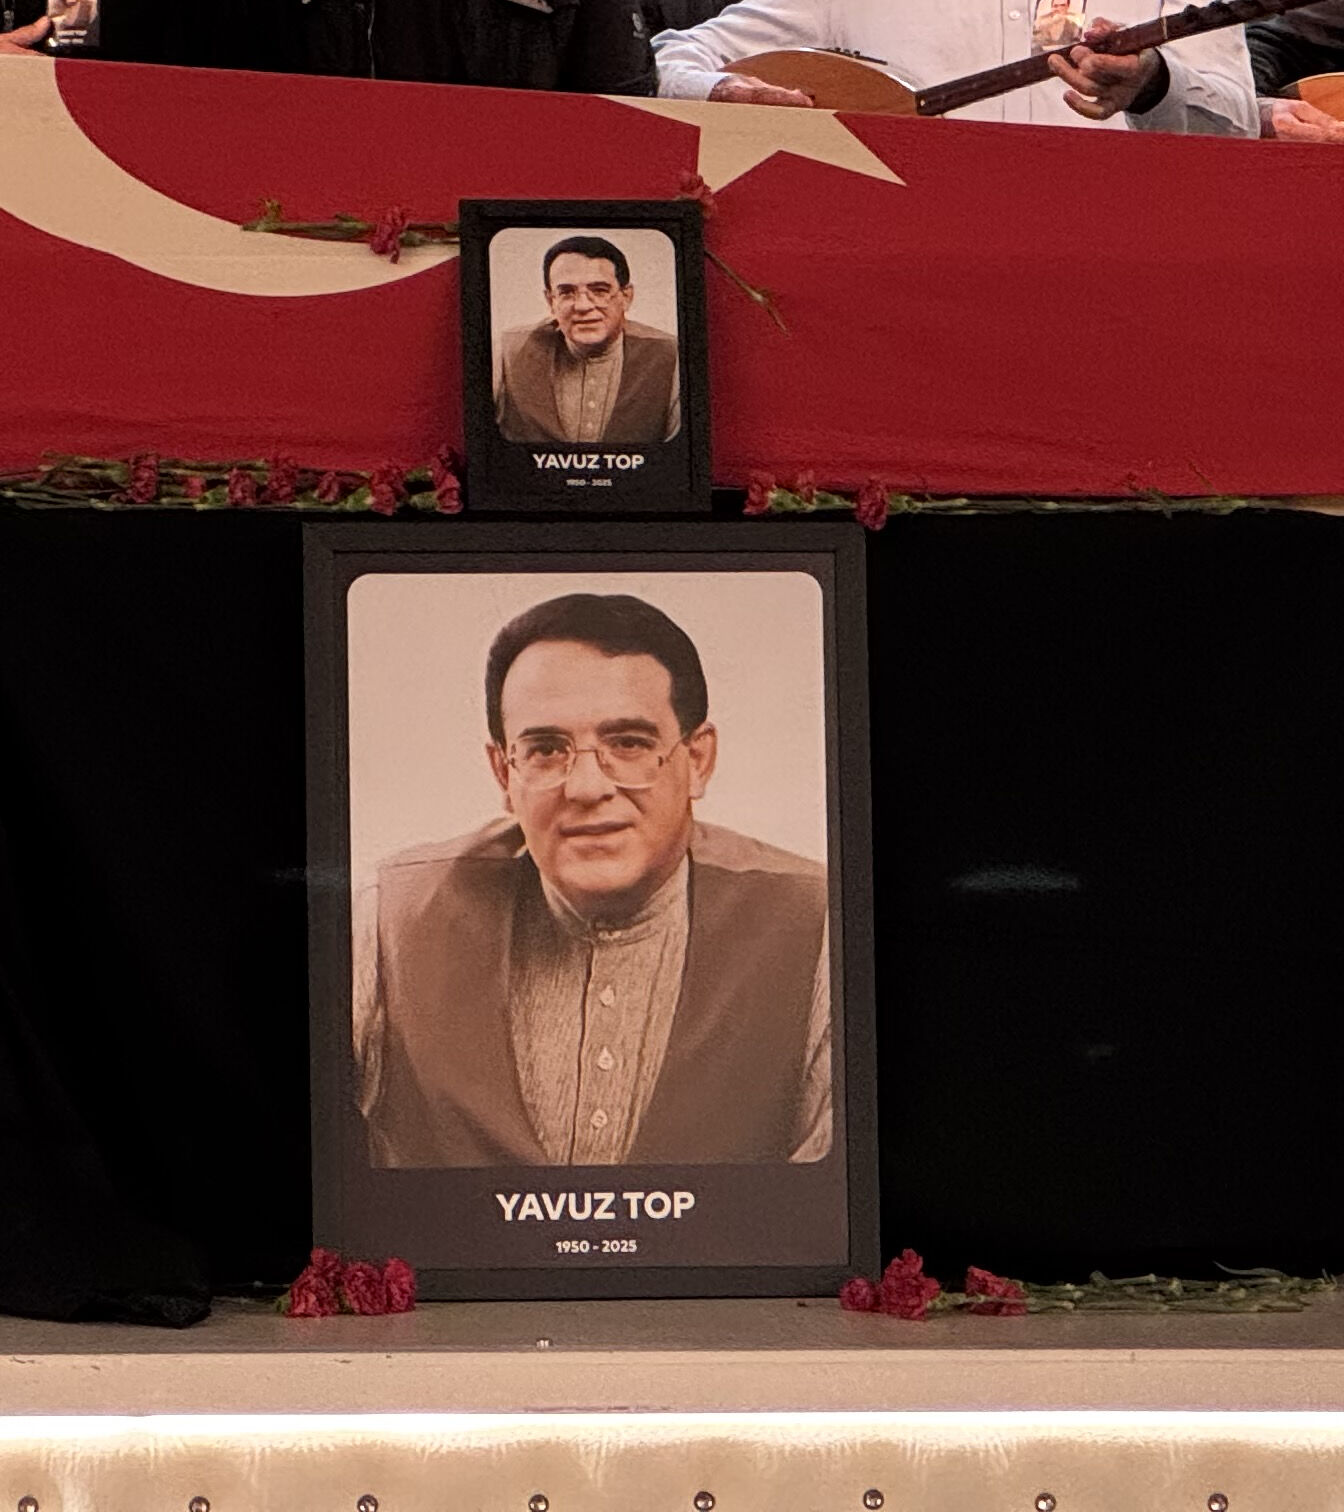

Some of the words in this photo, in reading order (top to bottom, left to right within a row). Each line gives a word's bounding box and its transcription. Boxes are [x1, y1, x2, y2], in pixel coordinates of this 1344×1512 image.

[532, 453, 601, 469] YAVUZ
[603, 453, 645, 470] TOP
[495, 1192, 616, 1221] YAVUZ
[622, 1191, 696, 1220] TOP
[556, 1240, 590, 1254] 1950
[601, 1239, 638, 1254] 2025
